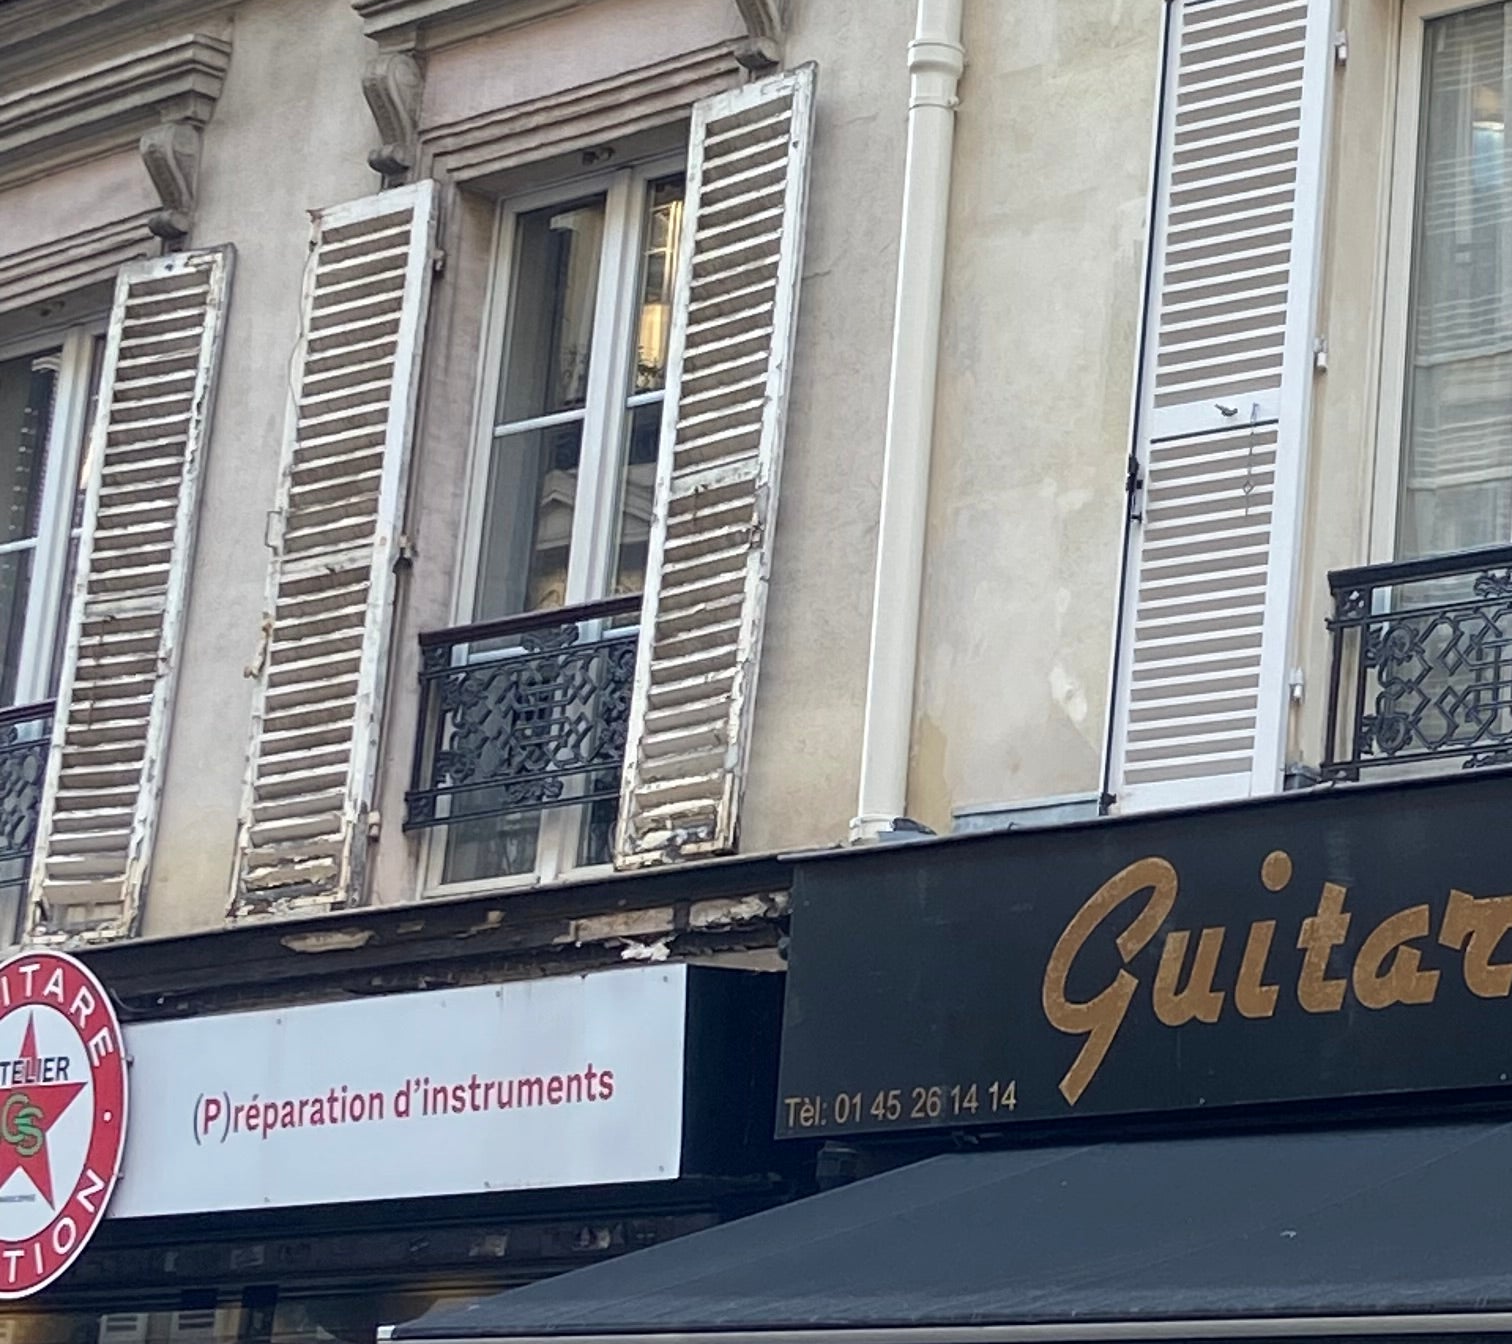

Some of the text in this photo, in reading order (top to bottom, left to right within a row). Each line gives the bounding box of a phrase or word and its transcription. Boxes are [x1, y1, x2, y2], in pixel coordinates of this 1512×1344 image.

[192, 1084, 385, 1146] (P)réparation
[833, 1092, 863, 1124] 01
[869, 1089, 902, 1121] 45
[910, 1086, 943, 1119] 26
[950, 1083, 980, 1114] 14
[987, 1080, 1018, 1112] 14
